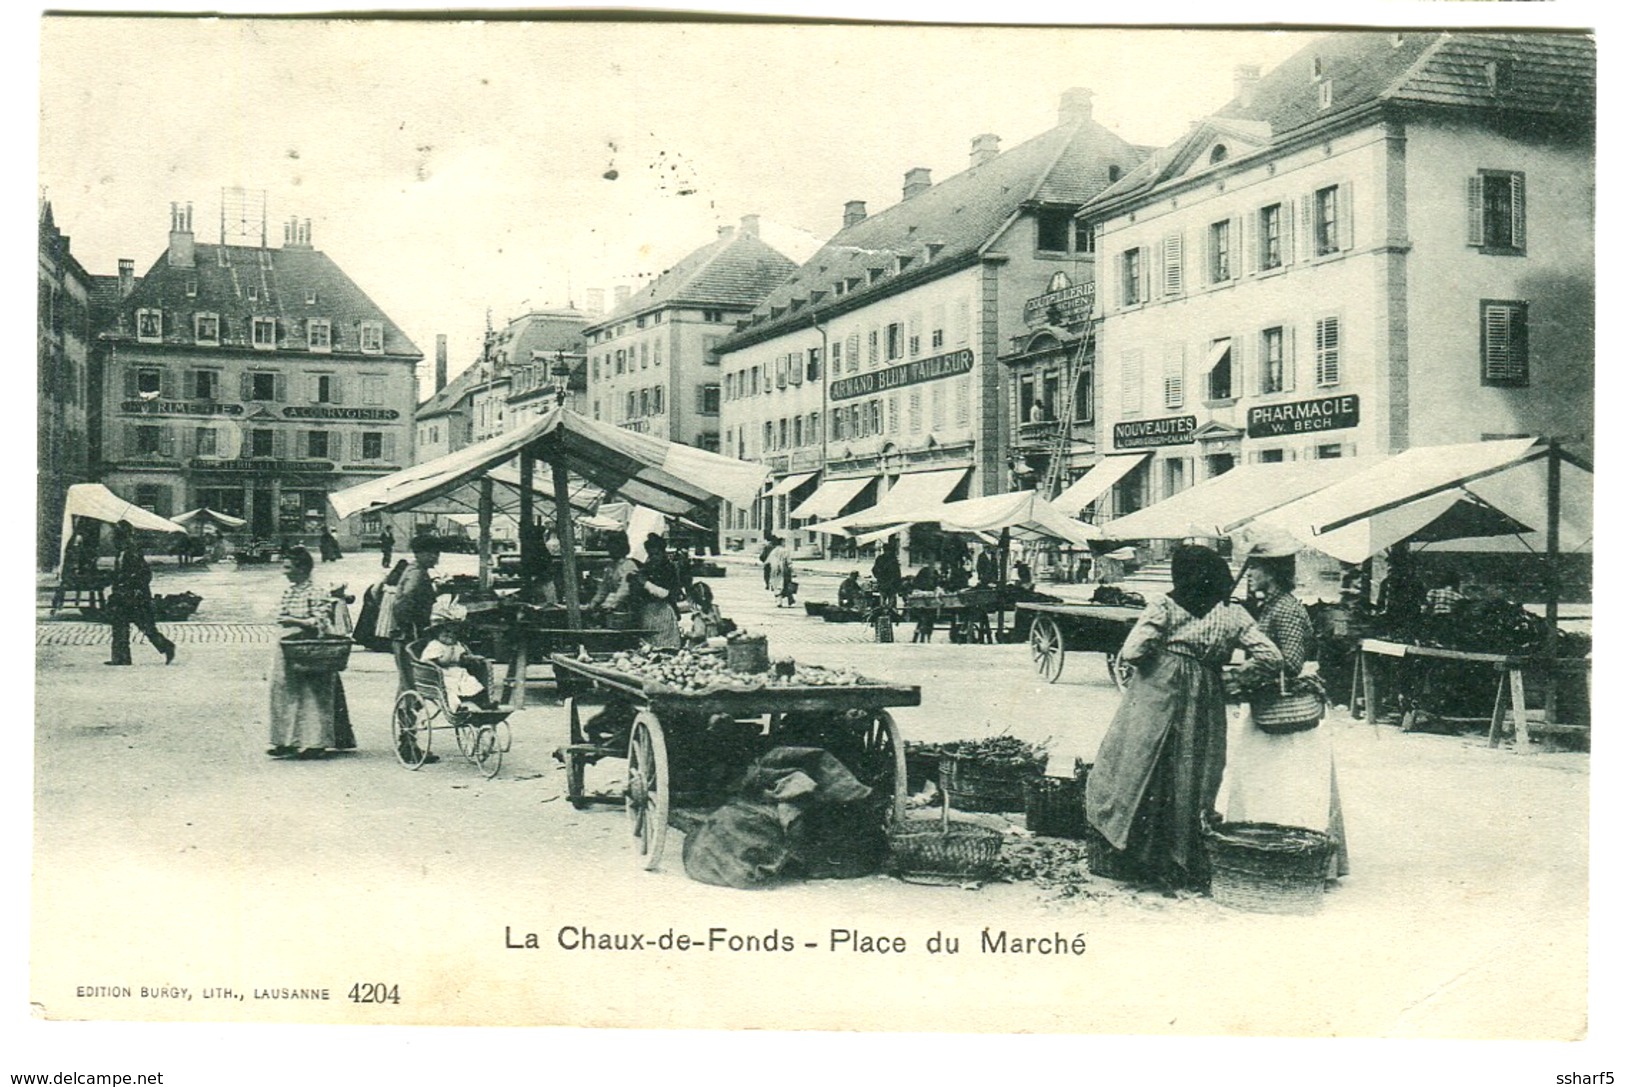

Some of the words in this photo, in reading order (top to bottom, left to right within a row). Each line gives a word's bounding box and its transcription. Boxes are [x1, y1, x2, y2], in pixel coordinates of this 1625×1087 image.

[832, 374, 874, 398] ARMAND
[878, 366, 908, 389] BLUM
[912, 351, 969, 380] TAILLEUR
[1253, 397, 1353, 424] PHARMACIE
[1116, 416, 1194, 438] NOUVEAUTÉS
[1271, 423, 1287, 433] W.
[1294, 418, 1332, 431] BECH
